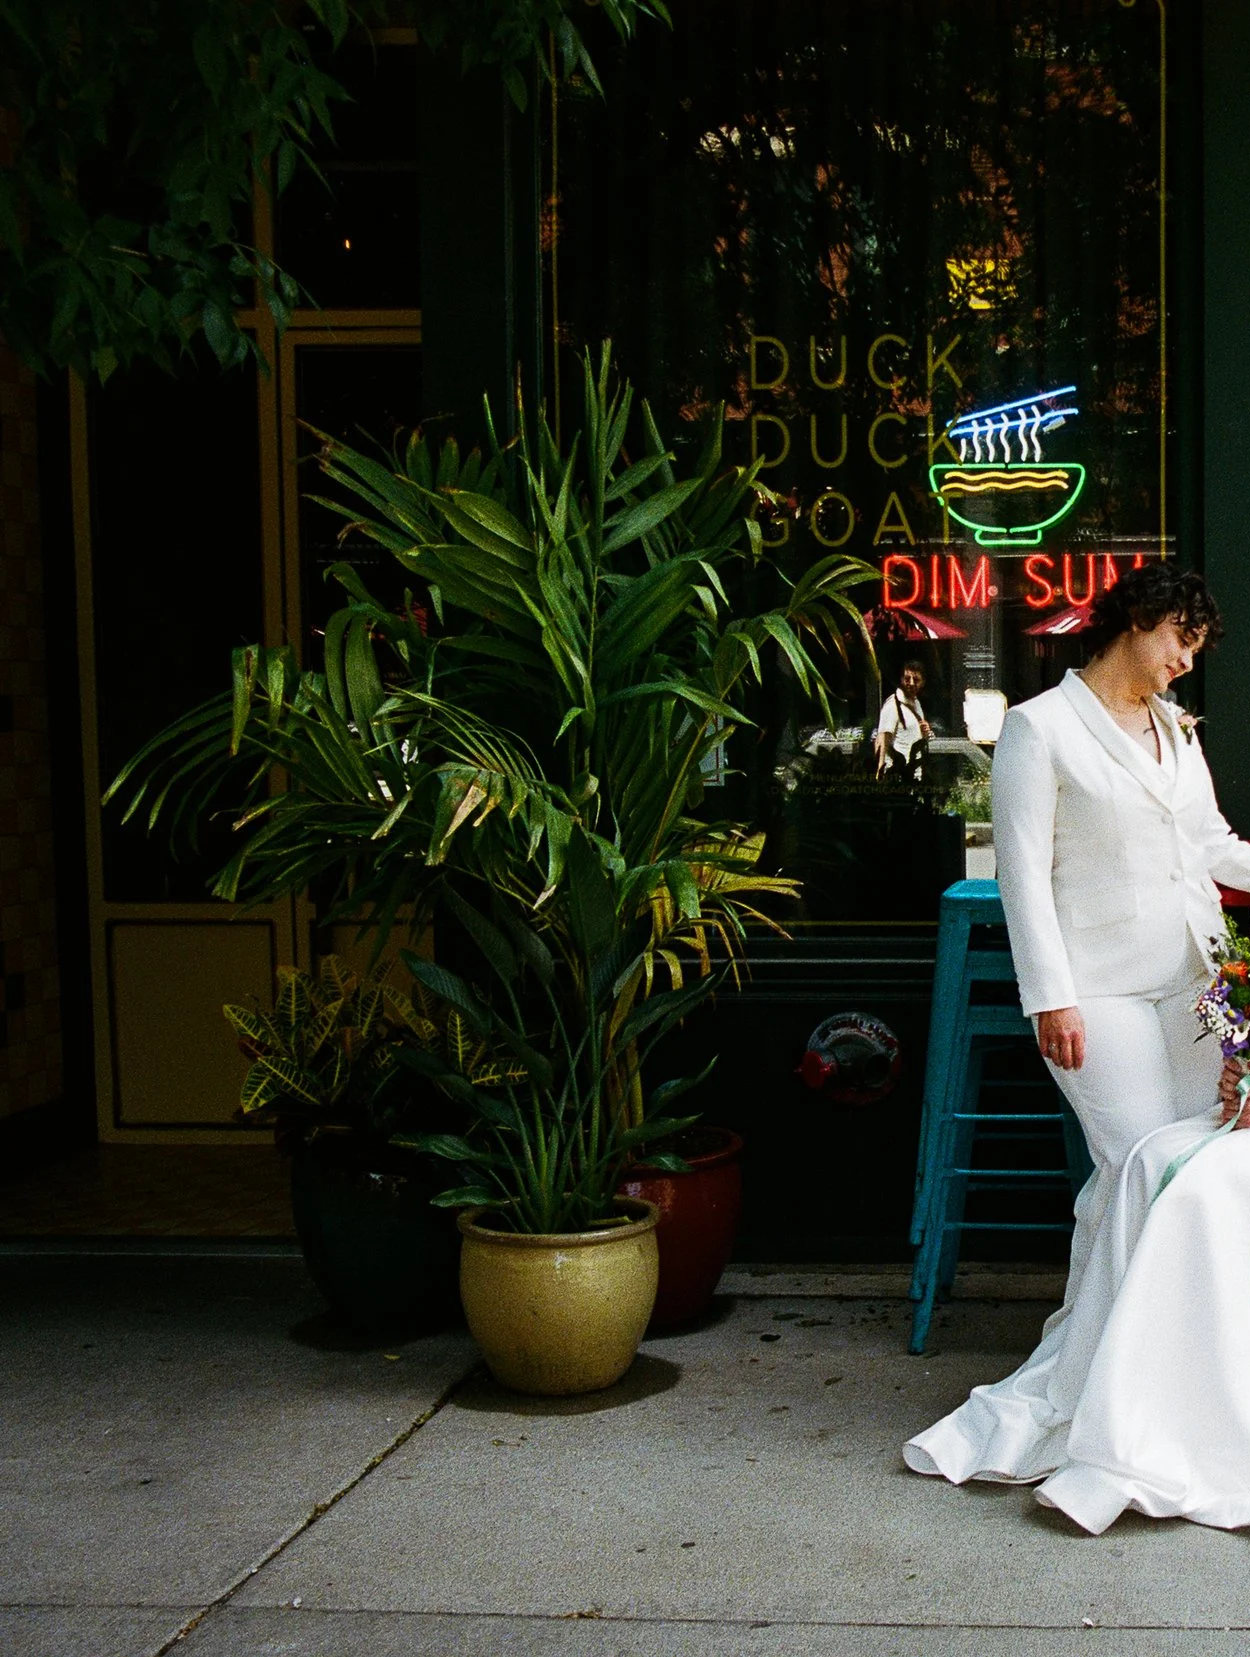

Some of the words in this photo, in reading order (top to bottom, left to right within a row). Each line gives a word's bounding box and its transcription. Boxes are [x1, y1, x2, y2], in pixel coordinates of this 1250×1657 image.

[750, 333, 963, 391] DUCK
[750, 413, 963, 468] DUCK
[750, 490, 967, 548] GOAT
[882, 554, 990, 609] DIM
